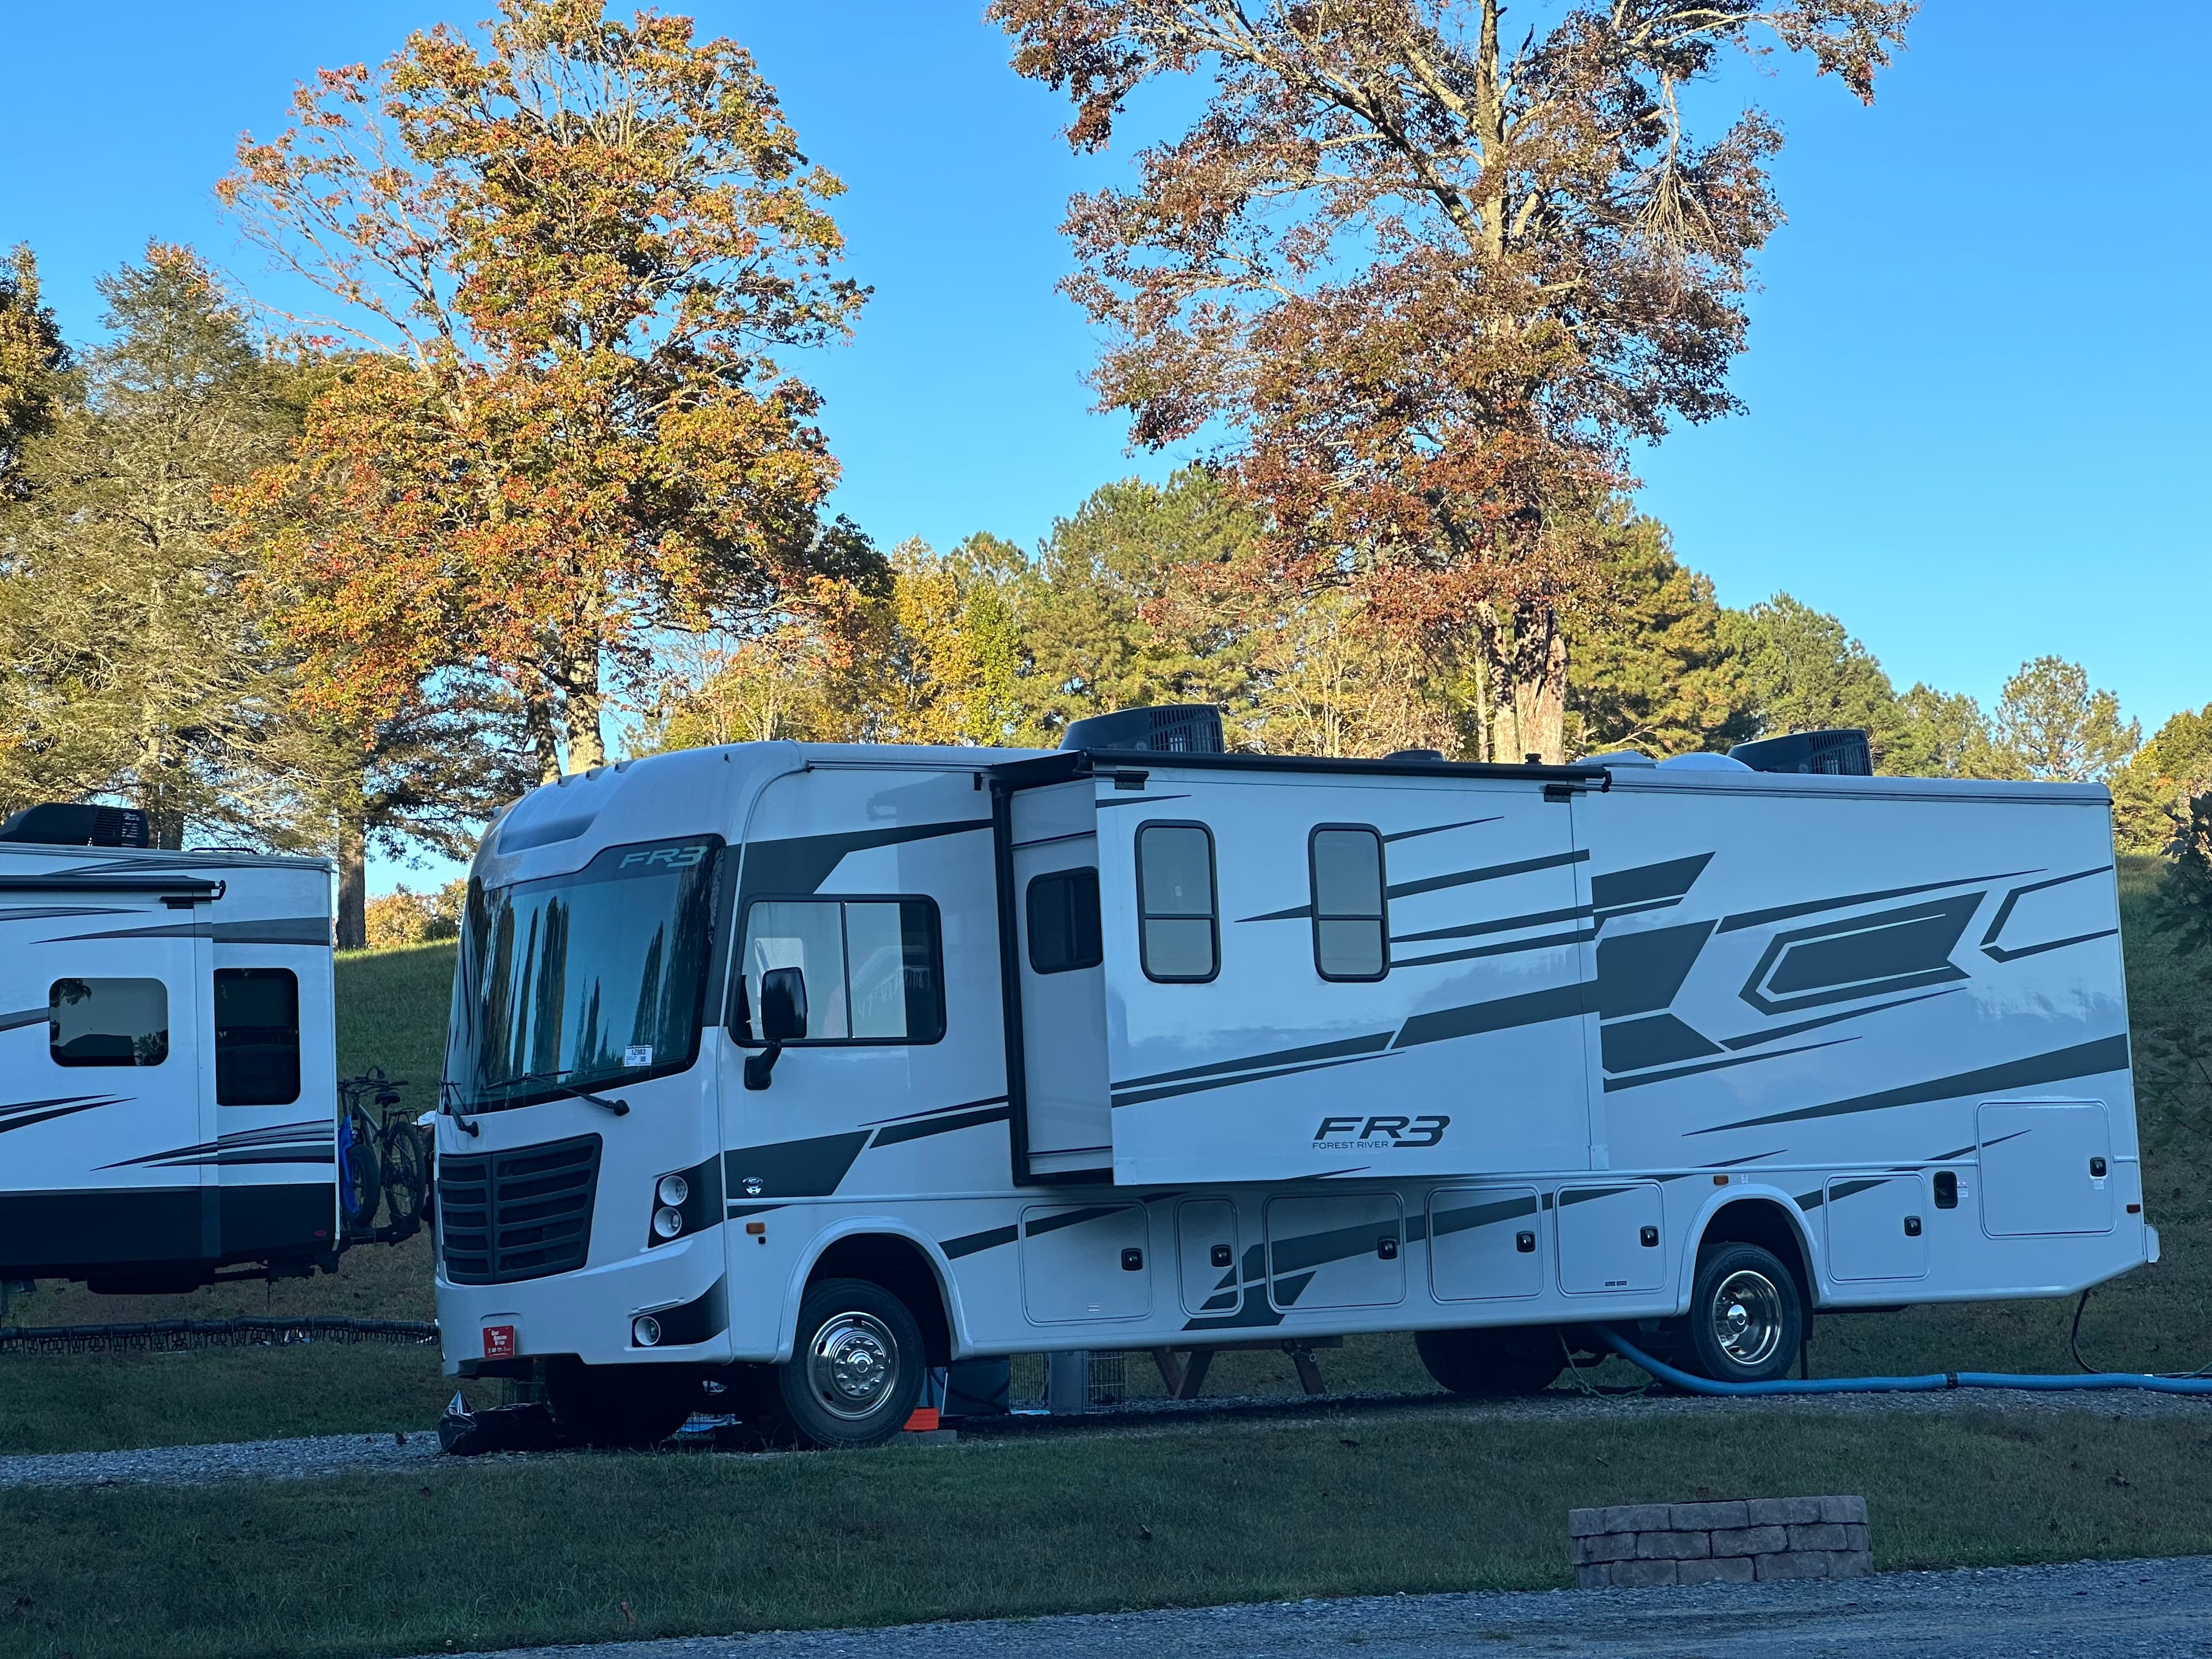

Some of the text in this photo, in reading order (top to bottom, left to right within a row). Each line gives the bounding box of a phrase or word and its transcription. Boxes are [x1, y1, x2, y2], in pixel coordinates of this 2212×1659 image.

[619, 846, 709, 869] FR3
[1313, 1115, 1450, 1147] FR3
[1312, 1142, 1354, 1150] FOREST
